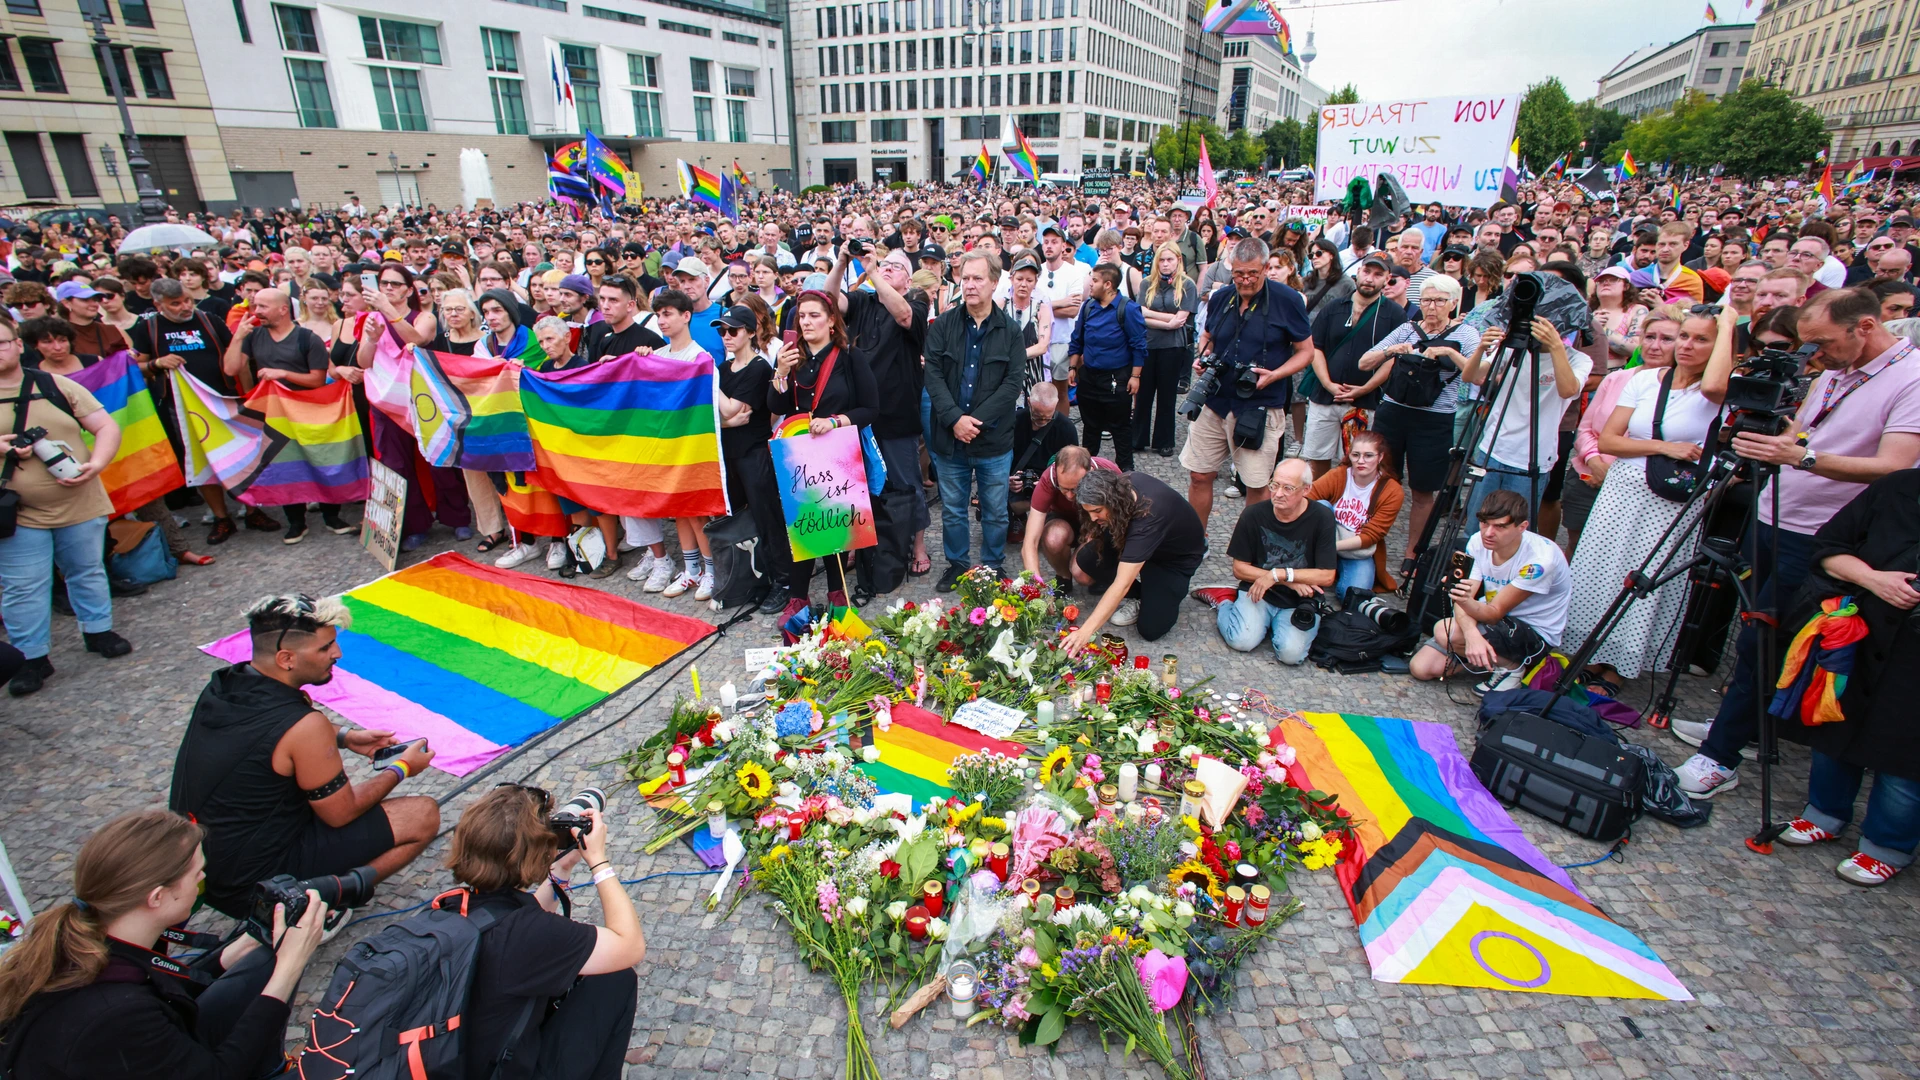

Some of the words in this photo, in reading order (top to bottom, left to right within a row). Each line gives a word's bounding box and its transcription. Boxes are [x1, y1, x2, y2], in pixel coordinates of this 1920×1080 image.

[165, 330, 201, 340] FOLSOM
[169, 344, 206, 352] EUROPE
[791, 464, 833, 493] Hass
[815, 479, 856, 503] ist
[794, 504, 866, 536] tödlich
[976, 721, 1004, 736] DANCE
[168, 932, 185, 940] EOS
[151, 956, 180, 972] Canon
